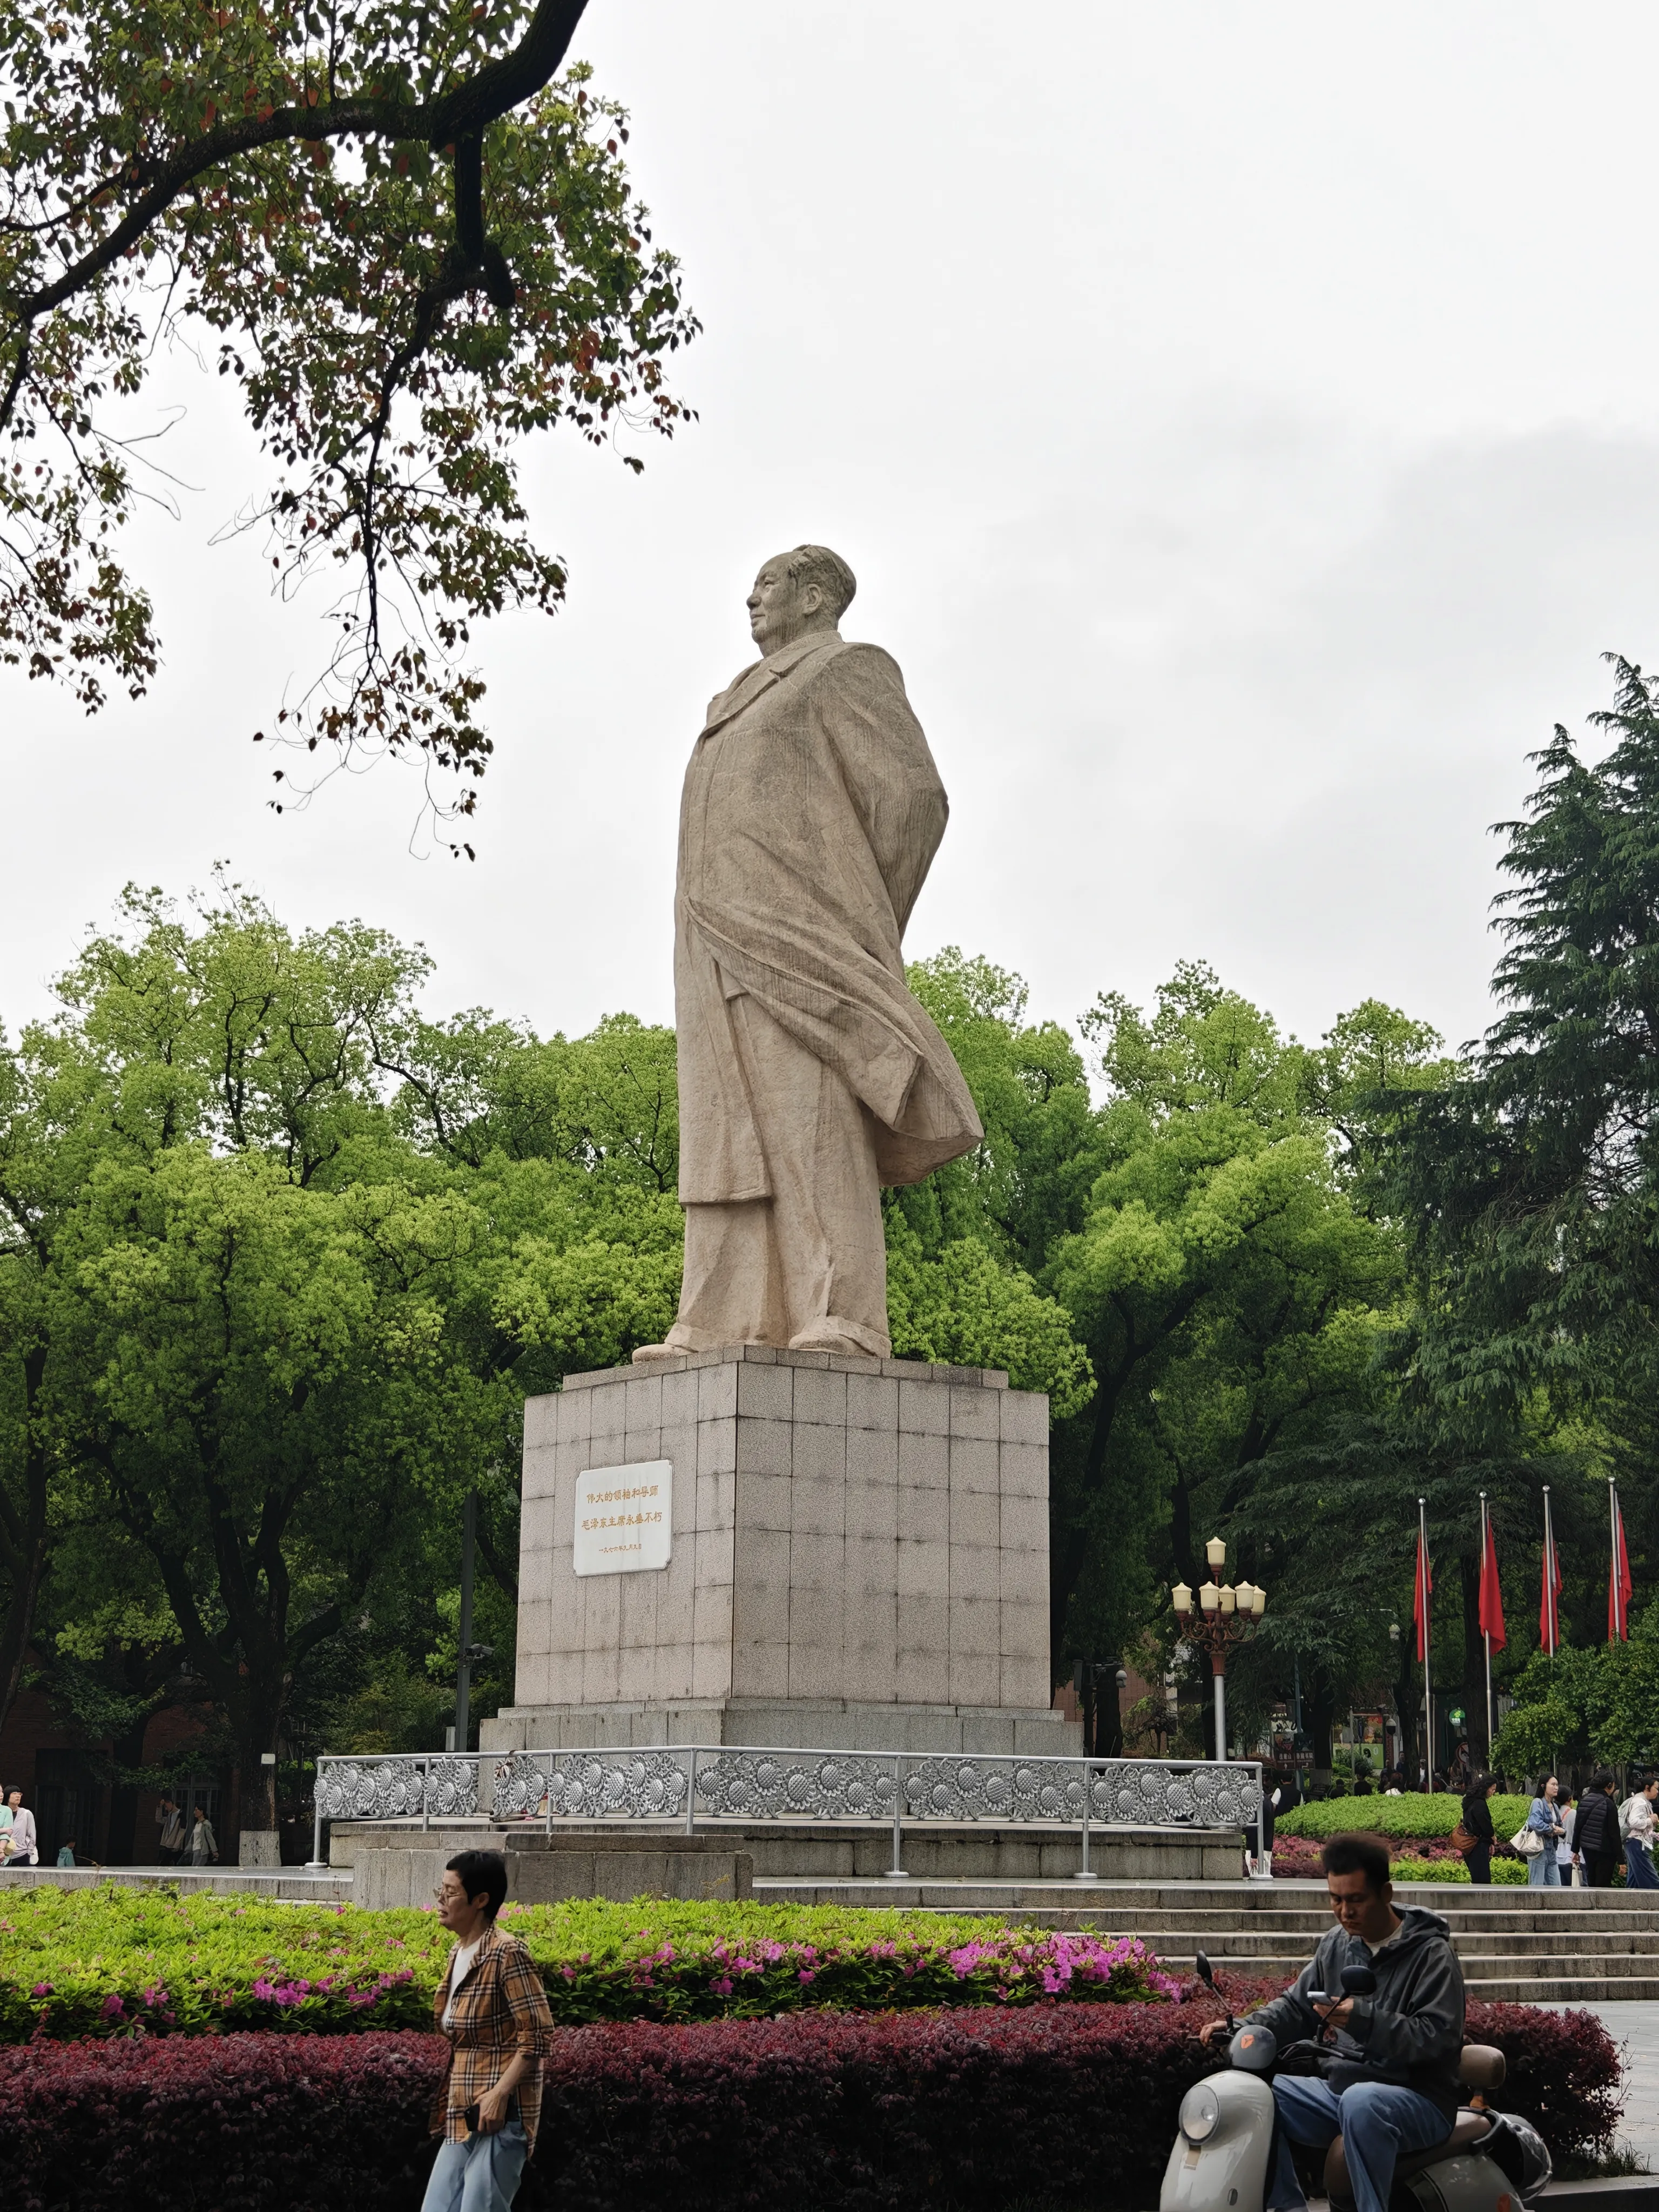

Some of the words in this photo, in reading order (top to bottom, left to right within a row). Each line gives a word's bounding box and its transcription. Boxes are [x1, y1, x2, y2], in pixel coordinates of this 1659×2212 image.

[586, 1485, 658, 1503] 伟大的领袖和导师
[582, 1511, 662, 1530] 毛泽东主席永垂不朽
